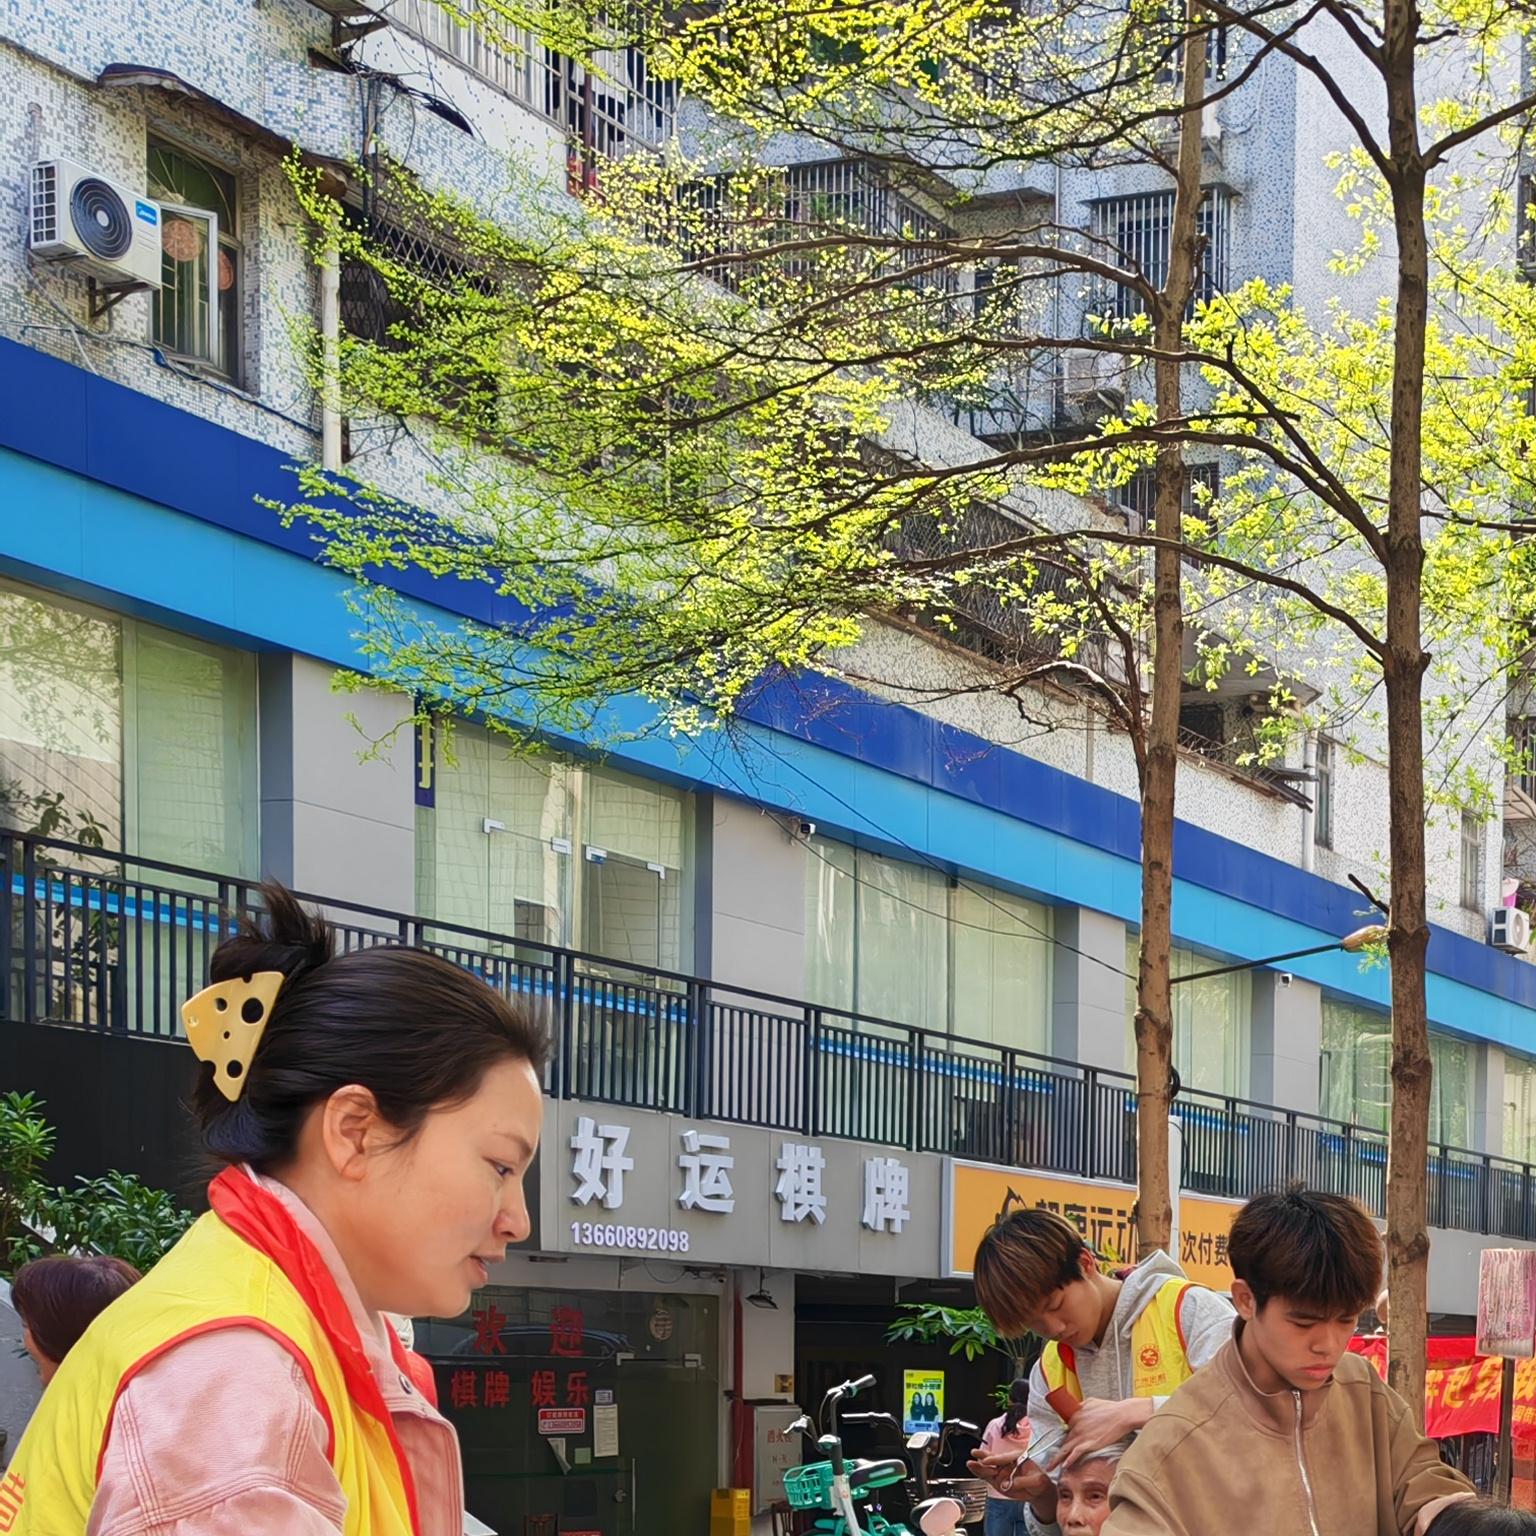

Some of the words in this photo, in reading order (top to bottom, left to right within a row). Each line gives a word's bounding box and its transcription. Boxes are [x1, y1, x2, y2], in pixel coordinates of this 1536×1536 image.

[570, 1116, 911, 1233] 好运棋牌
[571, 1222, 690, 1252] 13660892098
[450, 1370, 511, 1409] 棋牌
[531, 1370, 590, 1408] 娱乐
